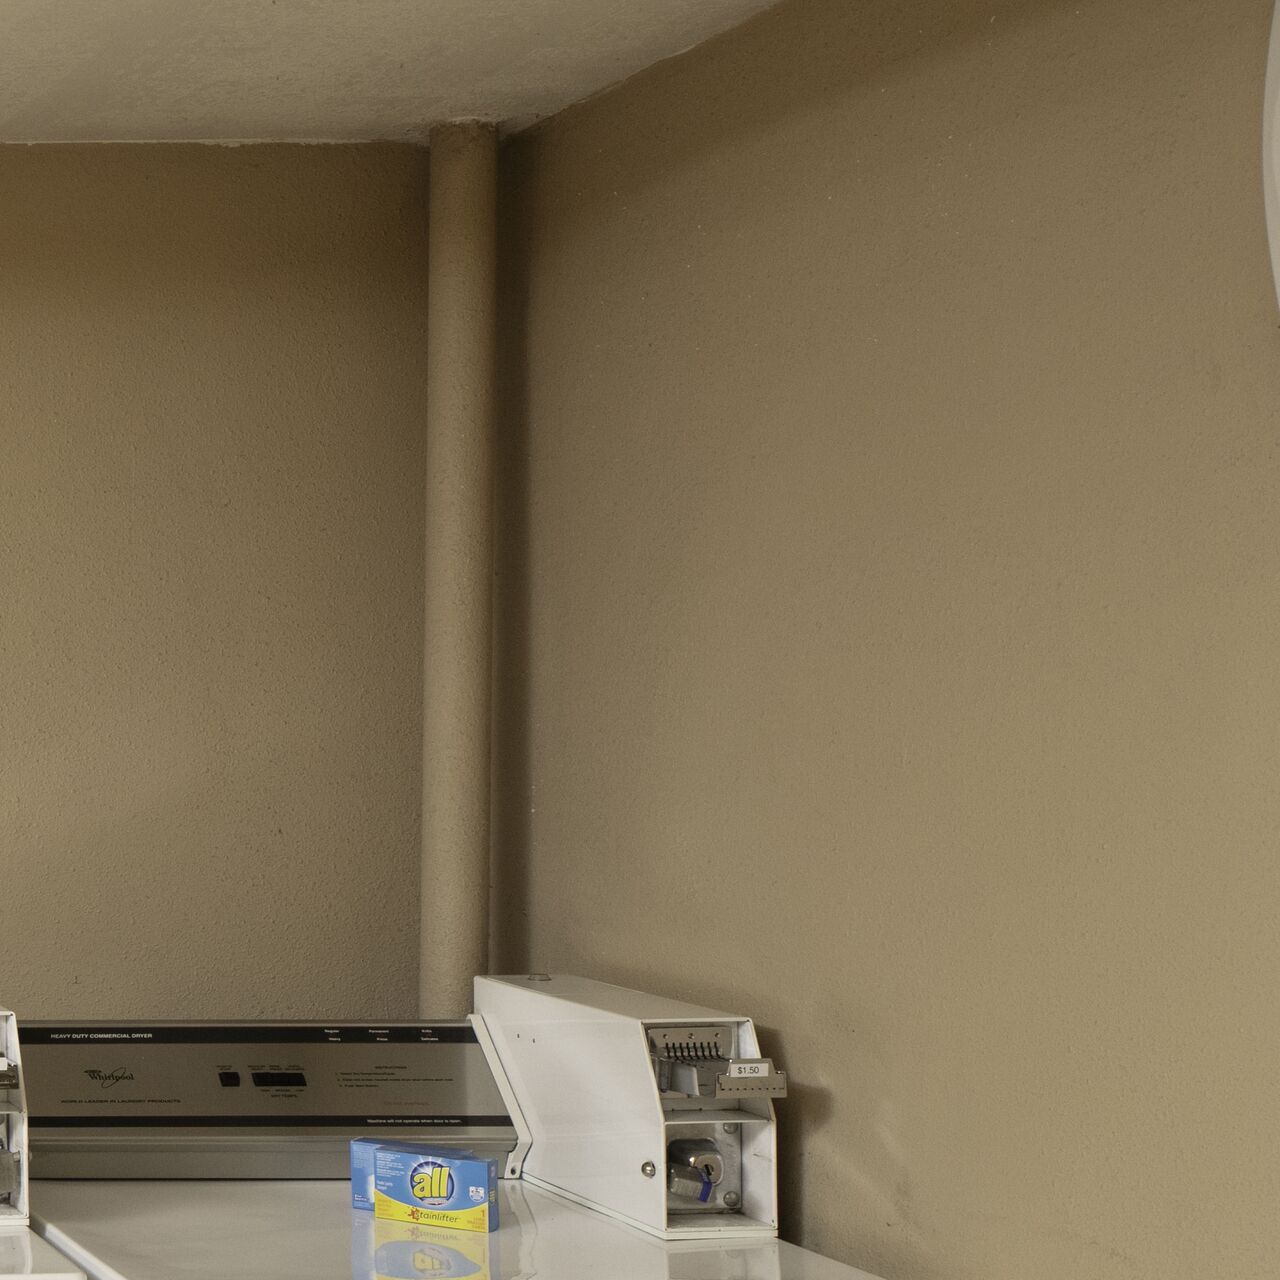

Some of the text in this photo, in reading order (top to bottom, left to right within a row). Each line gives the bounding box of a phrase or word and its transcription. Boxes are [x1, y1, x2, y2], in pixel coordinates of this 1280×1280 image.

[737, 1066, 760, 1075] $1.50
[87, 1071, 135, 1082] Whirlpool
[412, 1166, 450, 1199] all
